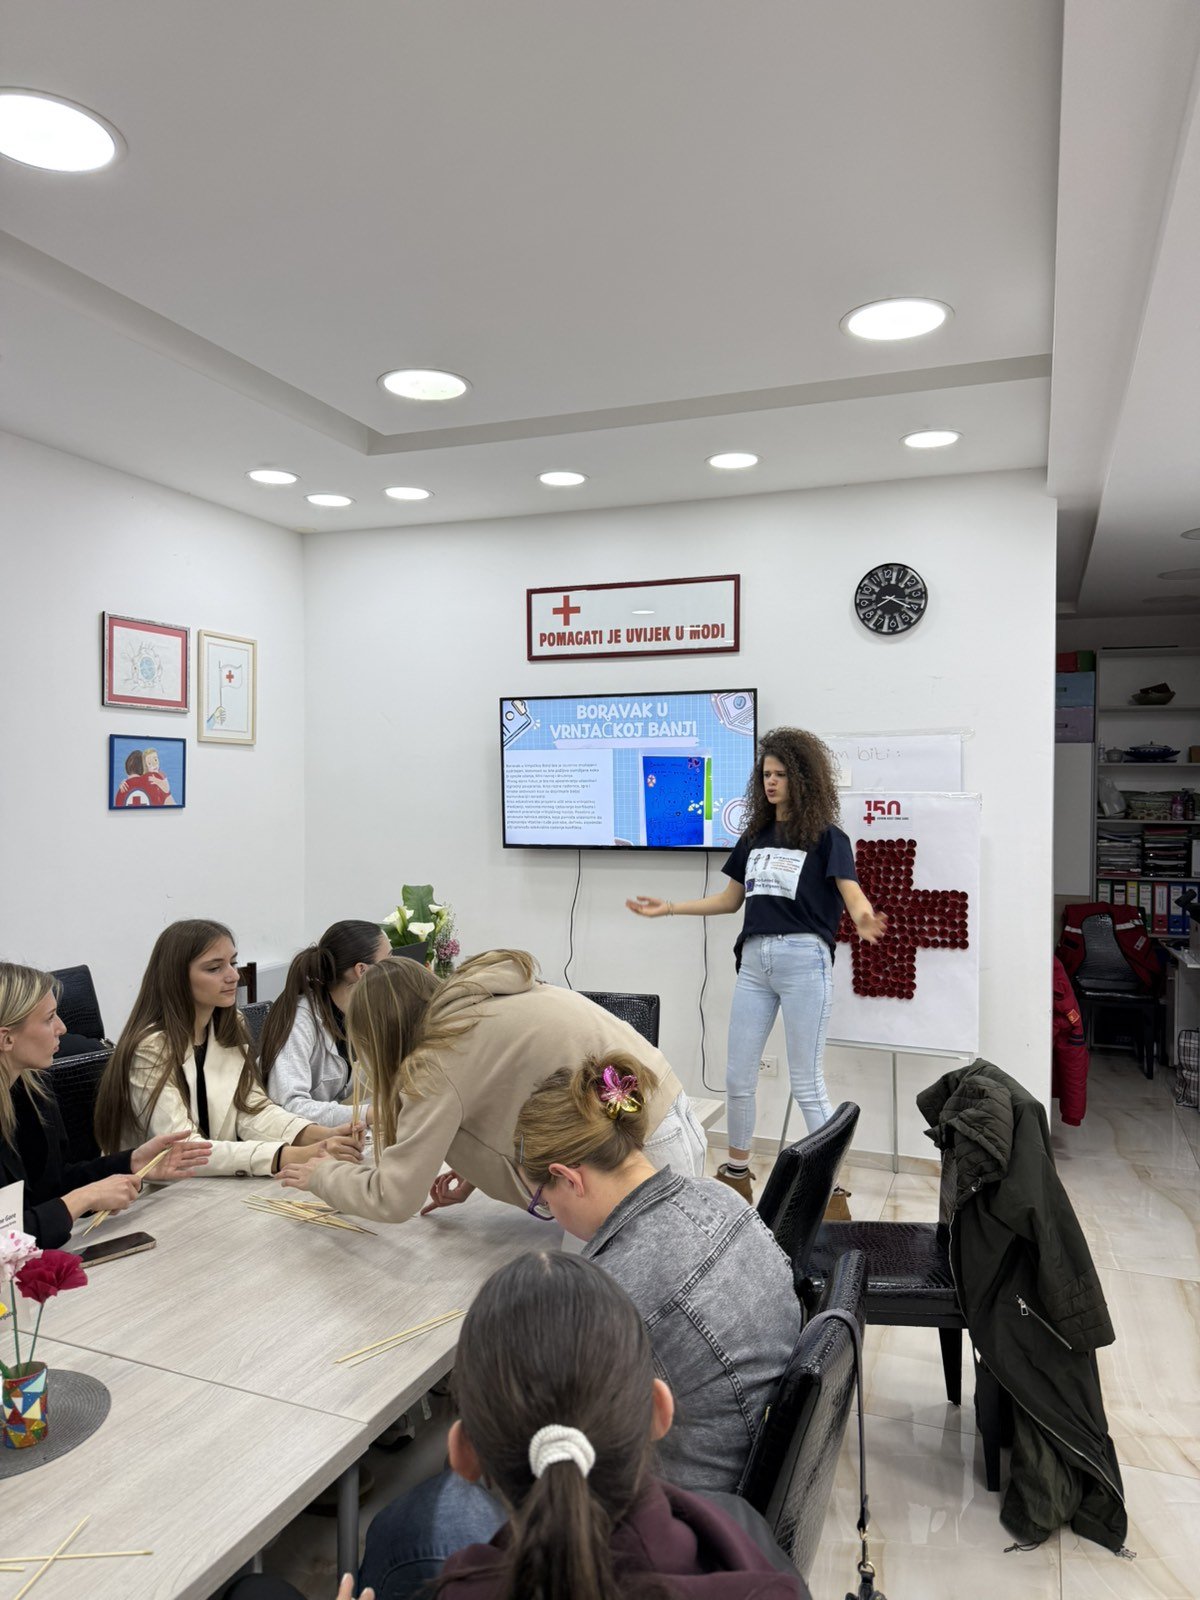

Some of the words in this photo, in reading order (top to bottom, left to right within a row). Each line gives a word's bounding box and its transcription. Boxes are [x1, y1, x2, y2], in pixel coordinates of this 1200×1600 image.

[884, 569, 892, 578] 12
[906, 578, 916, 586] 2
[862, 586, 872, 594] 10
[865, 610, 874, 618] 8
[901, 613, 910, 622] 5
[877, 617, 884, 626] 7
[889, 619, 896, 627] 6
[539, 630, 603, 647] POMAGATI
[607, 629, 621, 644] JE
[626, 626, 671, 643] UVIJEK
[675, 625, 685, 640] U
[689, 623, 725, 640] MODI
[576, 704, 653, 720] BORAVAK
[657, 702, 668, 717] U
[648, 720, 697, 737] BANJI
[865, 800, 901, 815] 150
